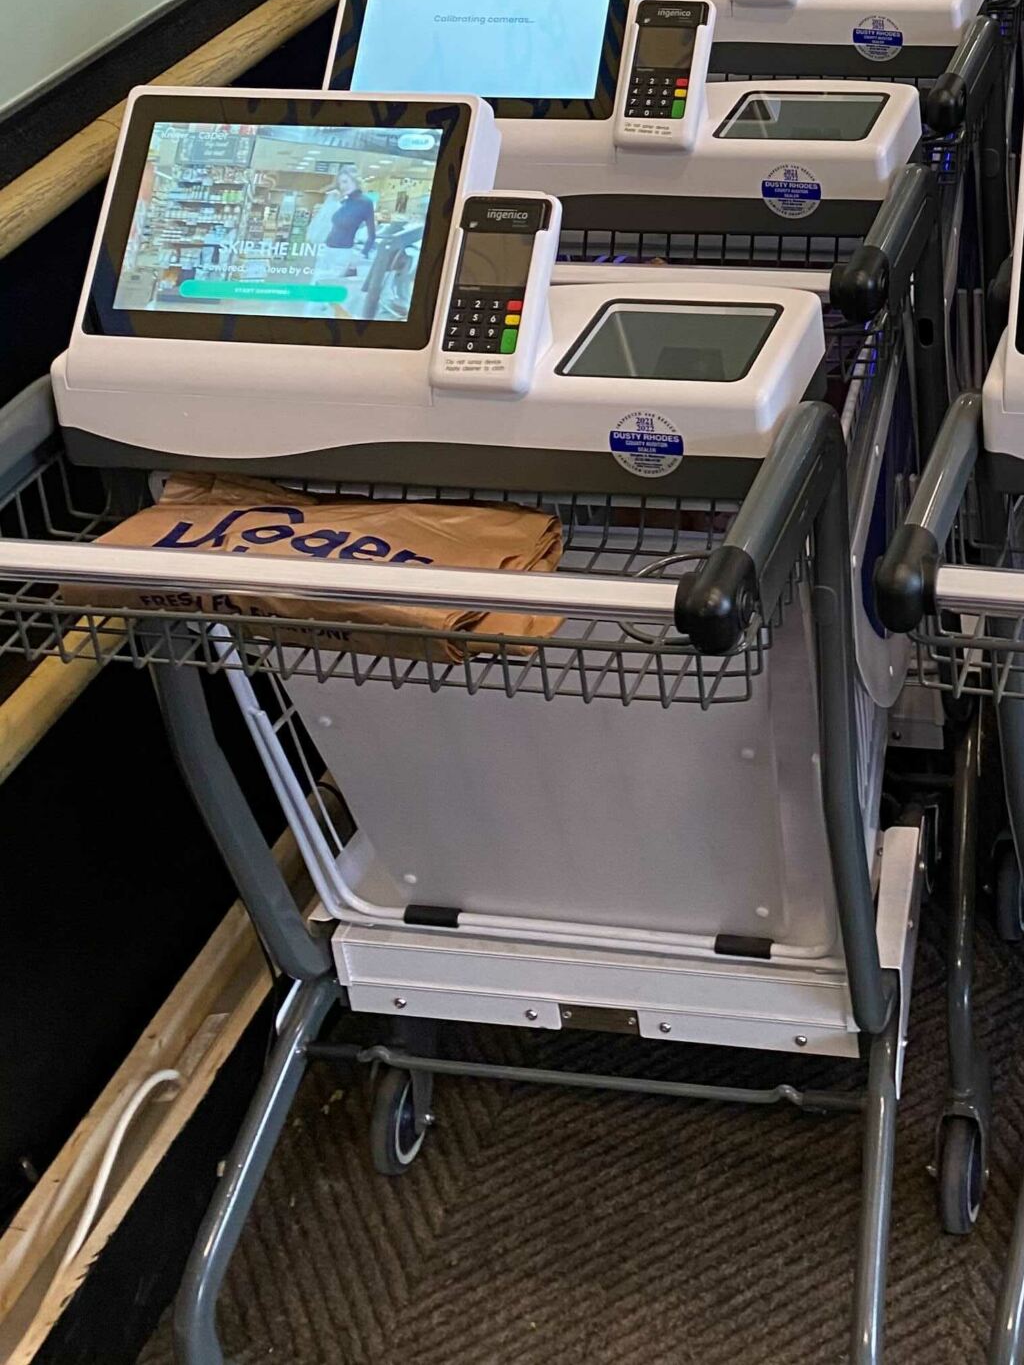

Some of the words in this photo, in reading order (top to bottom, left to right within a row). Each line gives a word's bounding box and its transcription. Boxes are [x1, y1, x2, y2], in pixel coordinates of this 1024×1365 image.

[657, 9, 692, 18] ingenico
[434, 14, 486, 25] Calibrating
[487, 209, 529, 221] ingenico
[220, 241, 252, 254] SKIP
[255, 241, 290, 255] THE
[635, 417, 655, 426] 2021
[613, 431, 641, 440] DUSTY
[642, 433, 681, 443] RHODES
